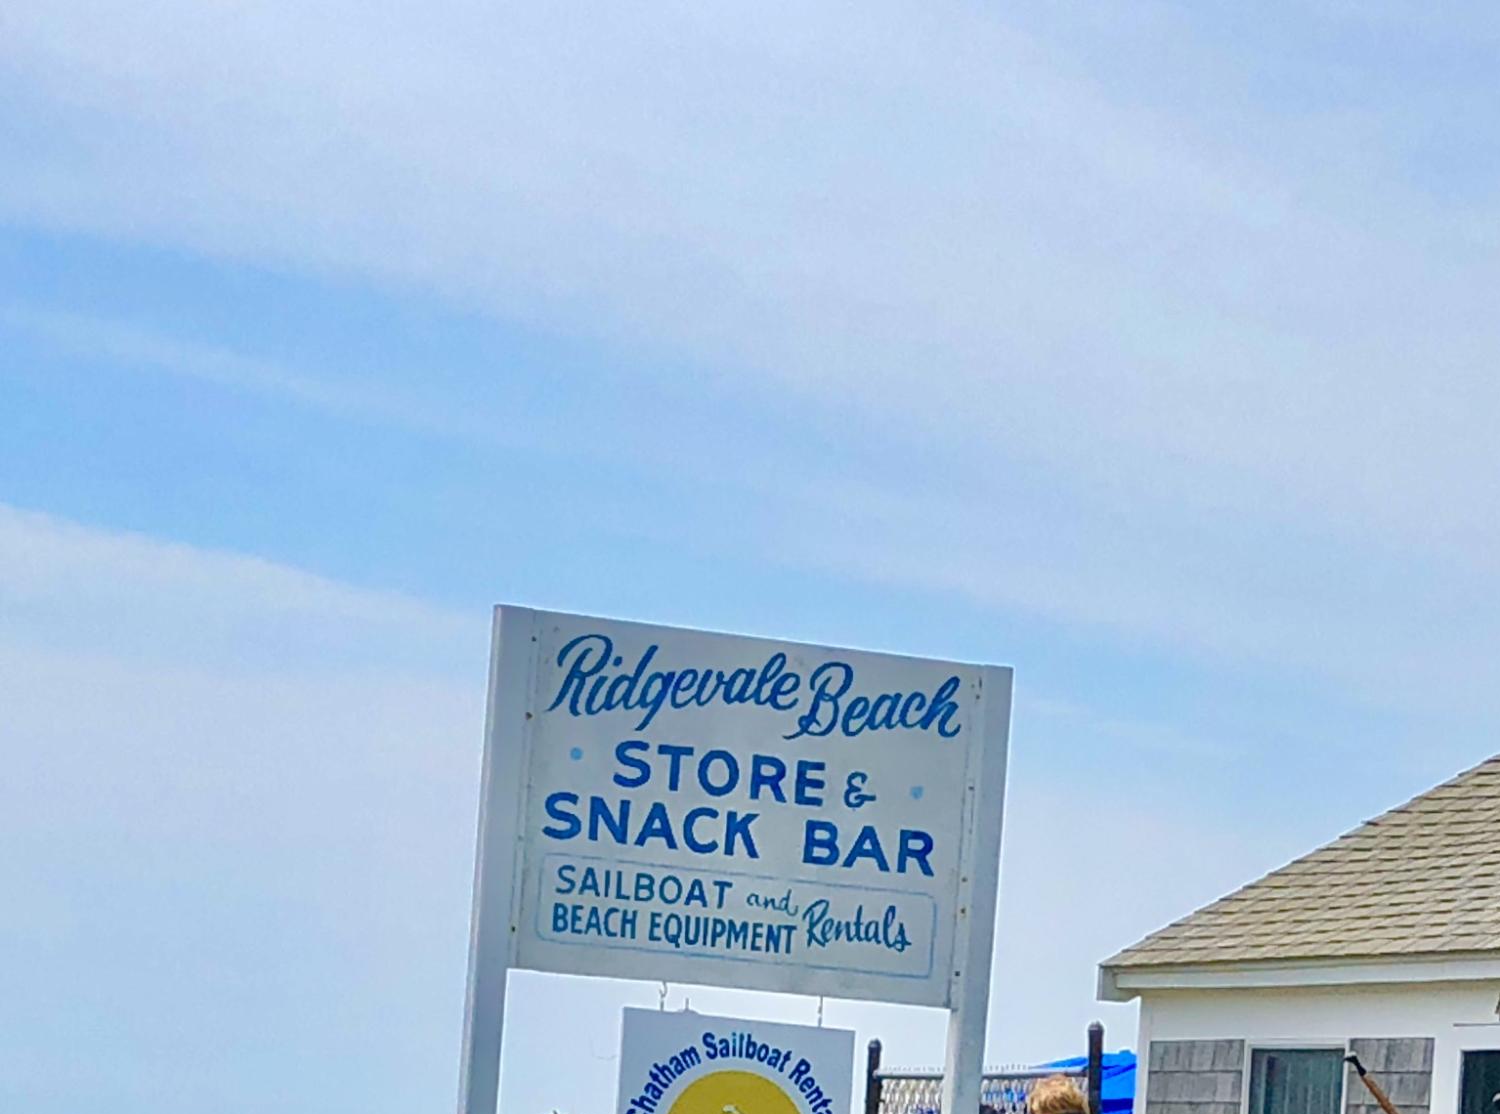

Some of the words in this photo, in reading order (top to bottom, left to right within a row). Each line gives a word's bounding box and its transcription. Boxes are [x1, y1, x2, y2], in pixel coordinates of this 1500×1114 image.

[547, 634, 800, 731] Ridgevale
[782, 661, 962, 740] Beach
[613, 741, 826, 807] STORE
[844, 771, 877, 809] &
[543, 792, 760, 859] SNACK
[803, 819, 935, 877] BAR
[555, 865, 733, 909] SAILBOAT
[746, 889, 798, 917] and
[552, 904, 637, 940] BEACH
[648, 913, 798, 954] EQUIPMENT
[801, 899, 912, 953] Rentals
[702, 1032, 793, 1073] Sailboat
